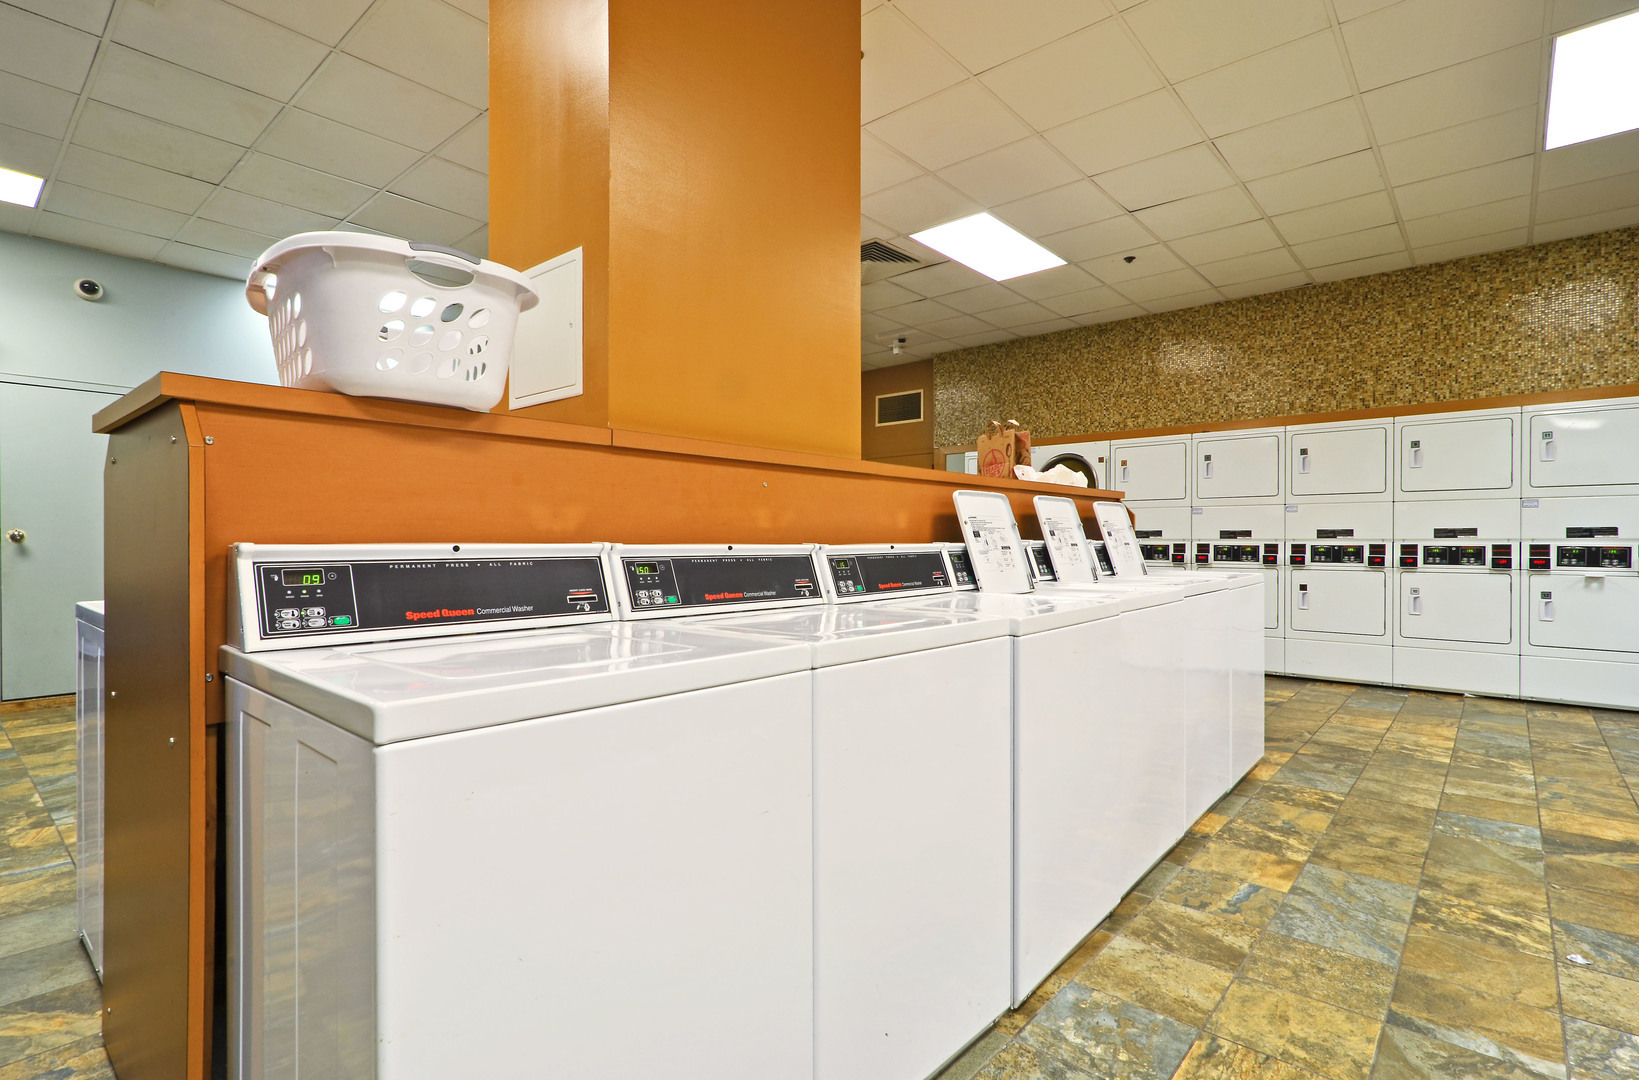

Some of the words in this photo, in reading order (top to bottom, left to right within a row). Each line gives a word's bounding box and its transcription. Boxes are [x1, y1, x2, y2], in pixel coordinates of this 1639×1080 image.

[705, 593, 724, 601] Speed
[405, 609, 441, 621] Speed
[441, 608, 475, 617] Queen
[476, 606, 512, 615] Commercial
